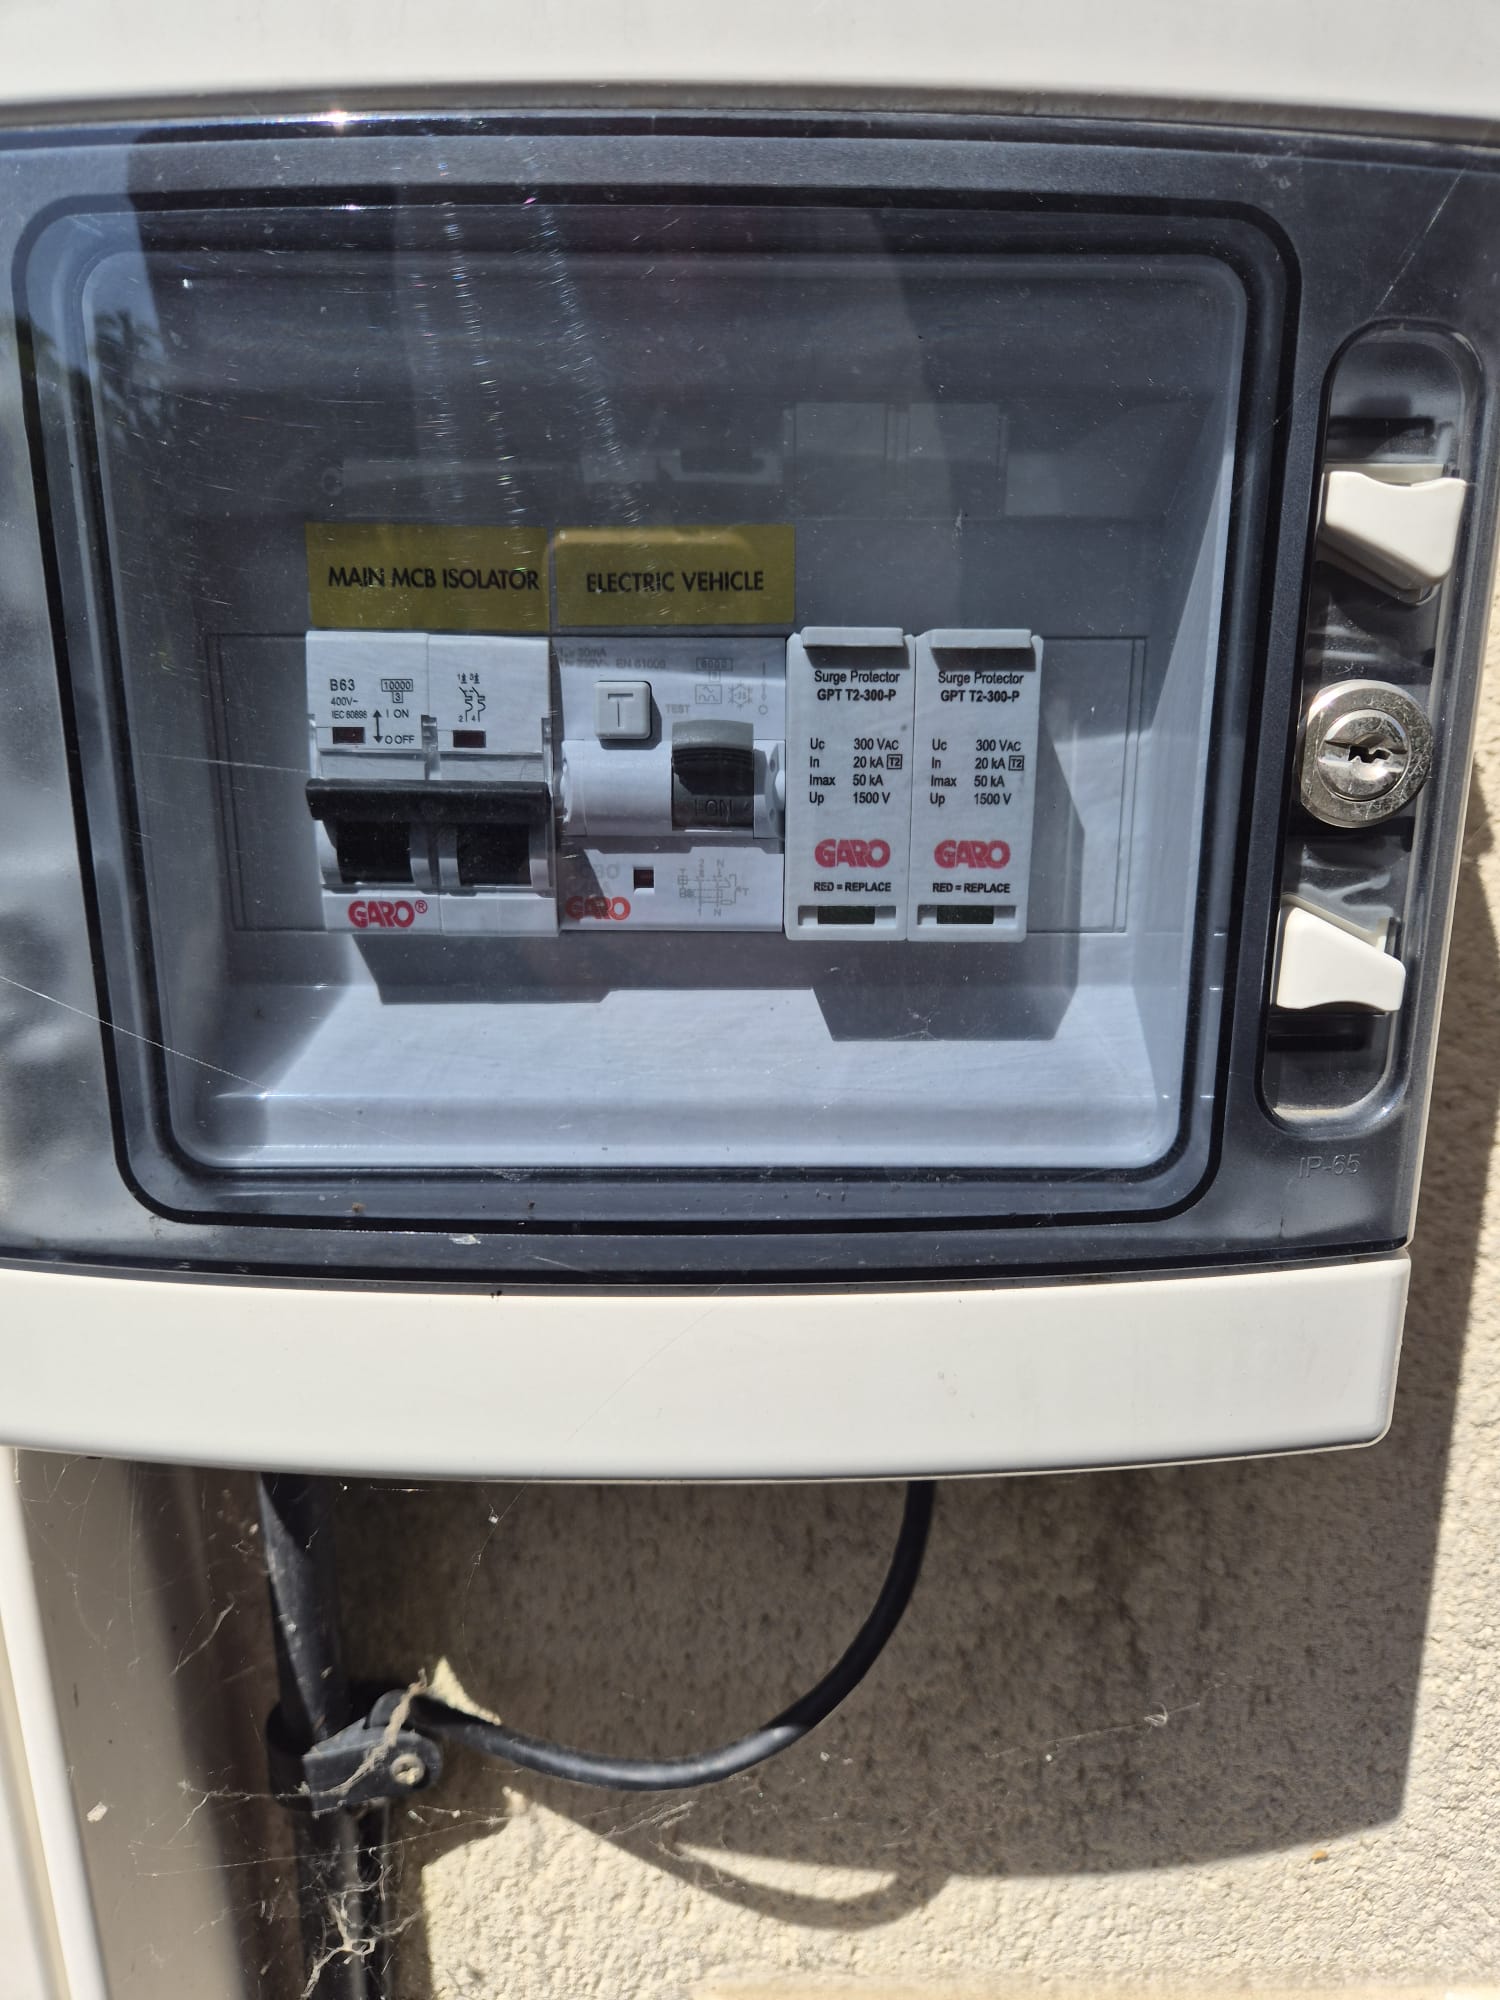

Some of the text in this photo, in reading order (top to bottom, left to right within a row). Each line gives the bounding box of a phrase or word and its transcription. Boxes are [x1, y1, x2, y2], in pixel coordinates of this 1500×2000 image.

[328, 566, 540, 590] MAIN MCB ISOLATOR
[586, 571, 764, 593] ELECTRIC VEHICLE
[814, 670, 900, 683] Surge Protector
[938, 672, 1024, 685] Surge Protector
[330, 679, 355, 691] B63
[384, 681, 411, 690] 10000
[395, 692, 401, 702] 3
[817, 689, 896, 701] GPT T2-300-P
[940, 690, 1020, 702] GPT T2-300-P
[393, 709, 409, 718] ON
[665, 703, 689, 714] TEST
[331, 711, 345, 719] IEC
[395, 735, 415, 744] OFF
[810, 738, 825, 750] Uc
[854, 738, 874, 750] 300
[932, 739, 947, 751] Uc
[976, 739, 996, 751] 300
[853, 756, 867, 768] 20
[869, 756, 884, 768] kA
[889, 757, 901, 767] T2
[975, 757, 989, 769] 20
[991, 757, 1005, 769] kA
[1010, 758, 1022, 768] T2
[809, 774, 883, 786] Imax 50 kA
[931, 775, 1005, 787] Imax 50 kA
[809, 792, 891, 805] Up 1500 V
[930, 793, 1012, 806] Up 1500 V
[814, 839, 891, 868] GARO
[934, 840, 1010, 869] GARO
[814, 881, 834, 892] RED
[844, 882, 891, 892] REPLACE
[932, 882, 953, 893] RED
[963, 883, 1010, 893] REPLACE
[565, 895, 631, 920] GARO
[1299, 1153, 1361, 1178] IP-65
